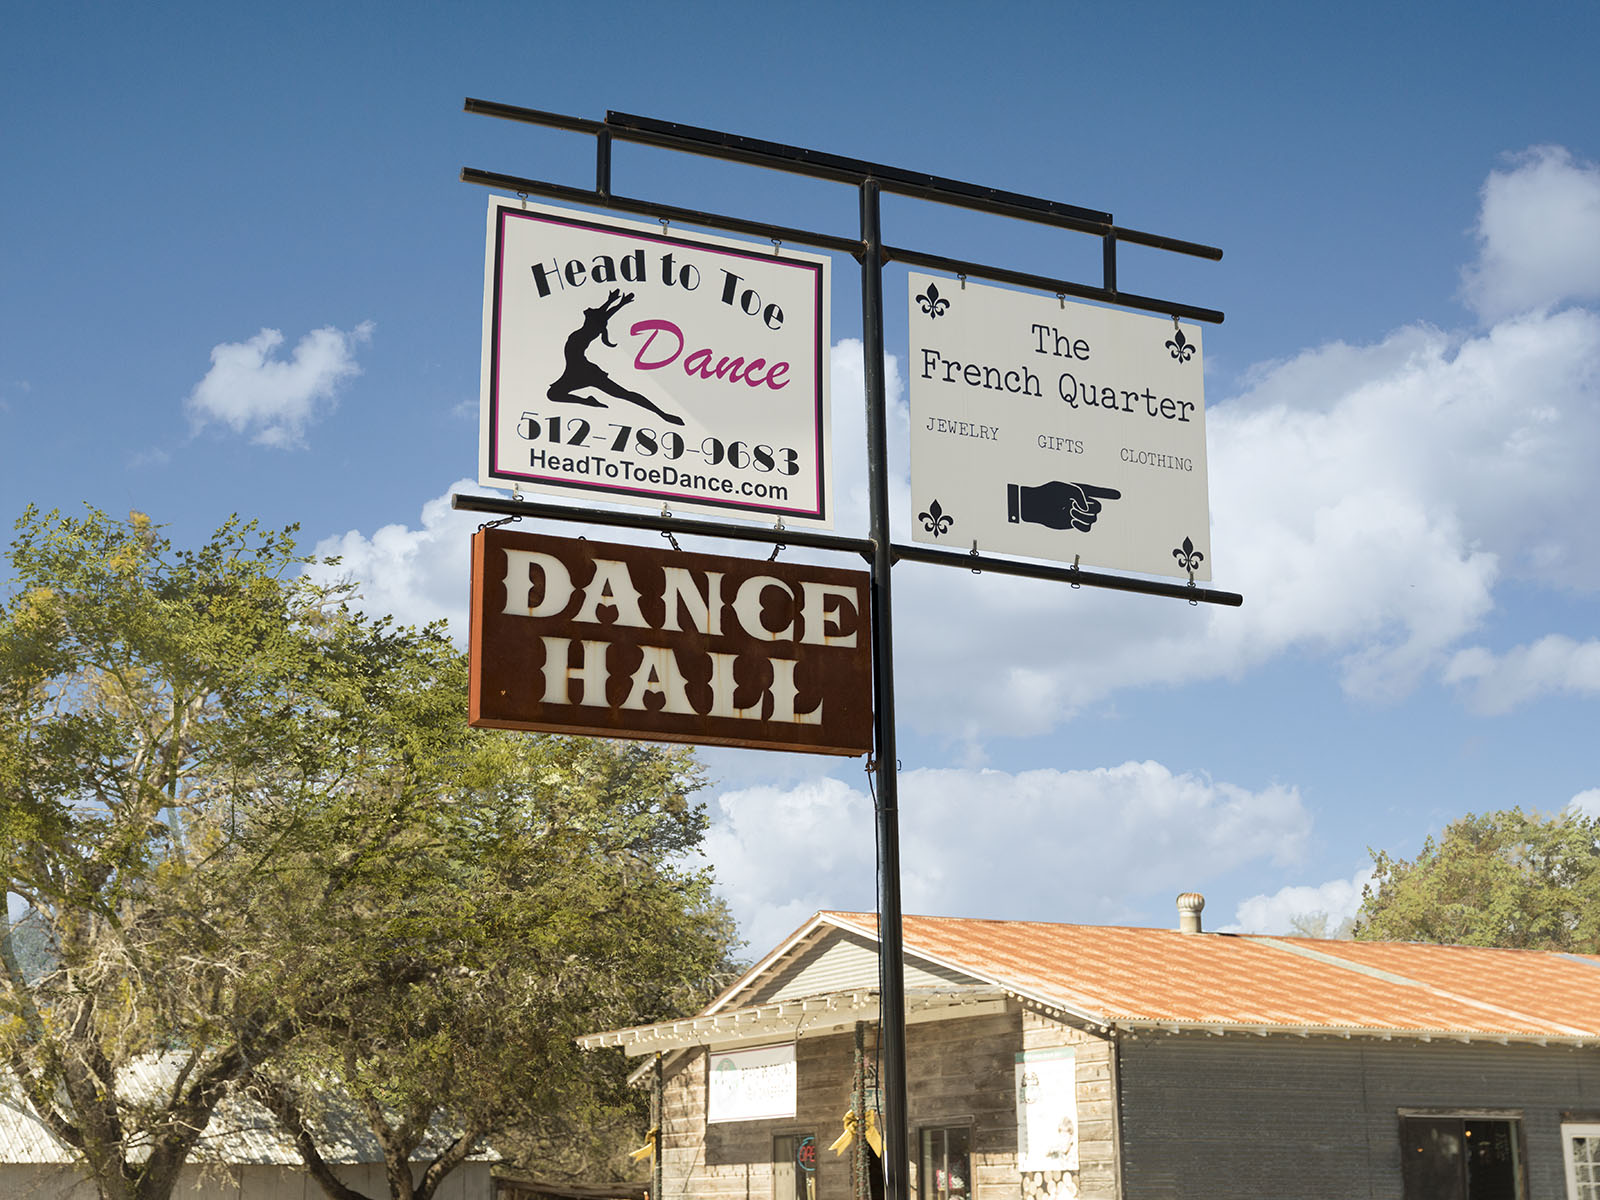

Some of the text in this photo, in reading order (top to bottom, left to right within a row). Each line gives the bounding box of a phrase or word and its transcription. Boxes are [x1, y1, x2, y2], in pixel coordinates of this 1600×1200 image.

[531, 250, 783, 330] Head to Toe
[630, 320, 790, 389] Dance
[1032, 324, 1089, 360] The
[921, 349, 1194, 422] French Quarter
[517, 412, 799, 475] 512-789-9683
[531, 448, 787, 500] HeadToToeDance.com
[927, 417, 1192, 471] JEWELRY GIFTS CLOTHING
[502, 549, 859, 648] DANCE
[540, 636, 823, 725] HALL
[800, 1145, 816, 1162] OPE
